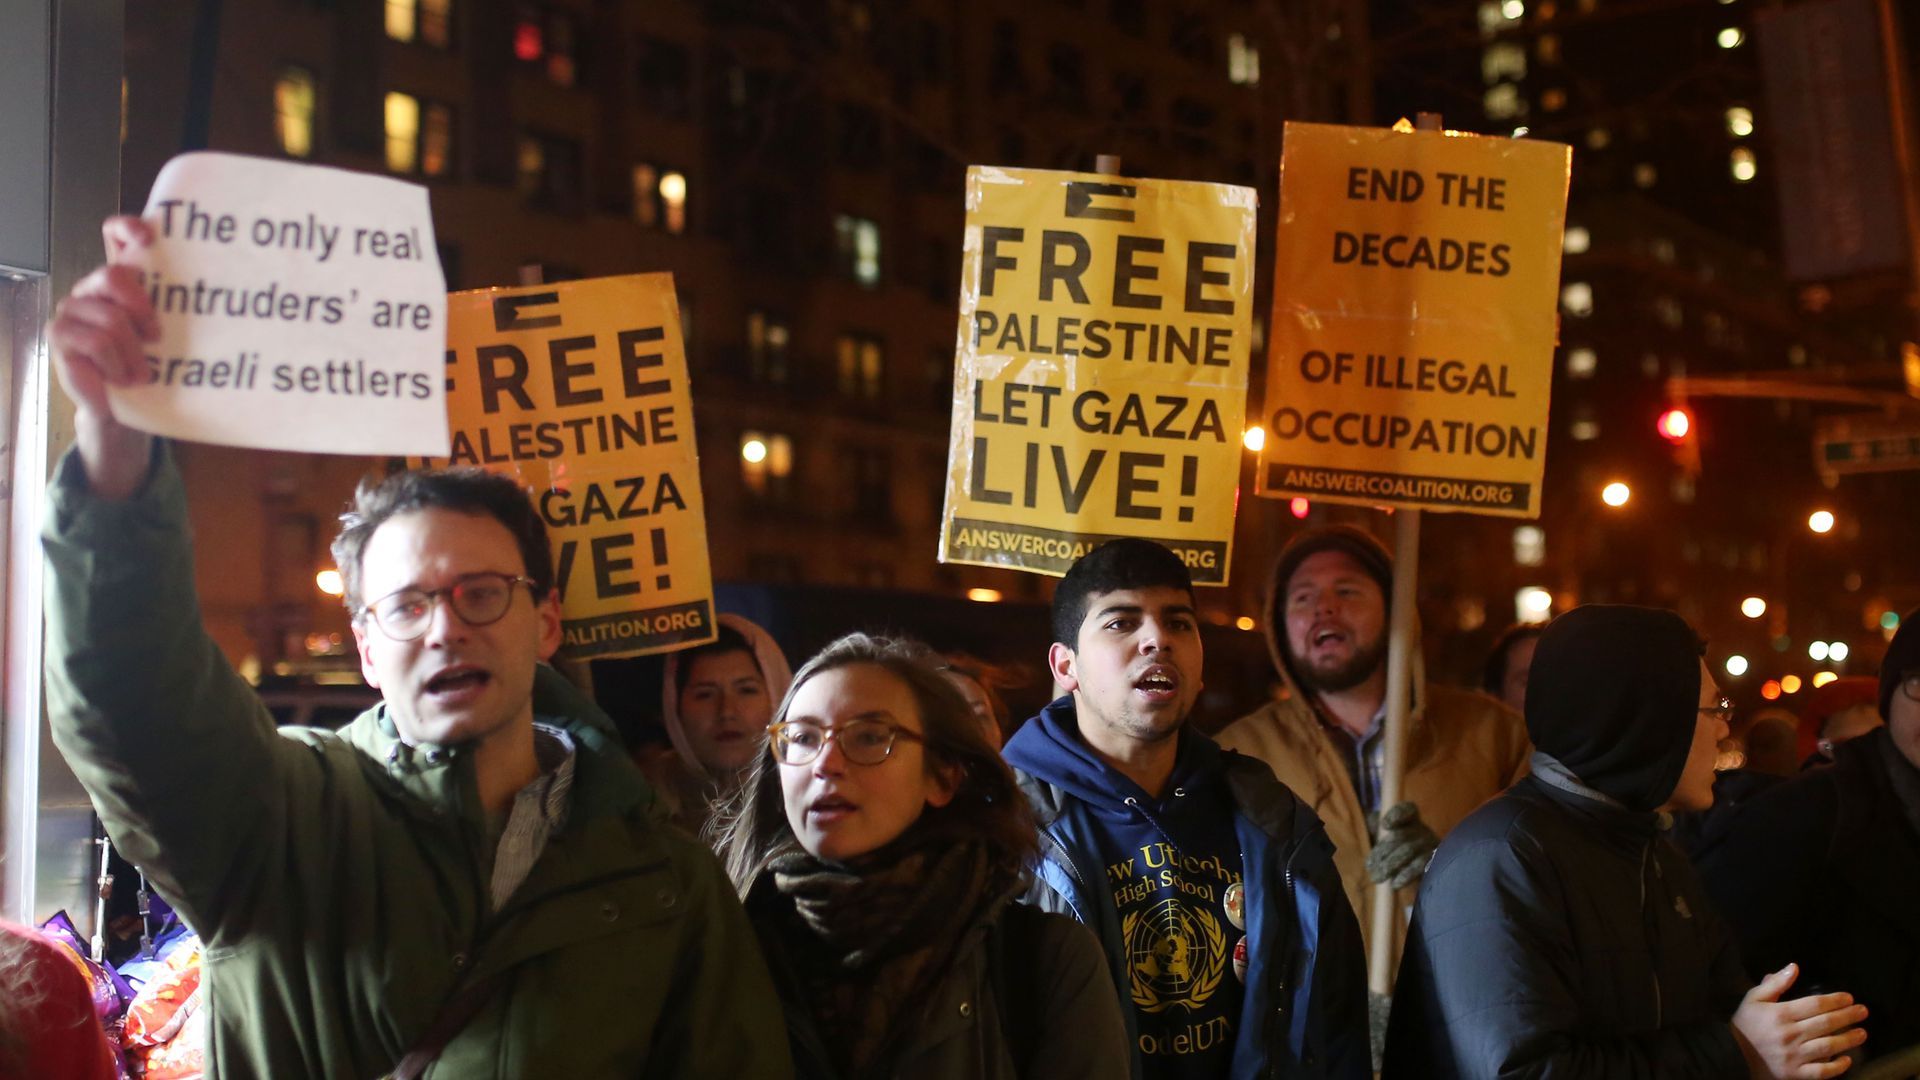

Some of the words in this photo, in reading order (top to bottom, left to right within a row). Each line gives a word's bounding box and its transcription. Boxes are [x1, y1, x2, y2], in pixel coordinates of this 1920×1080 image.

[1347, 167, 1424, 203] END
[1437, 172, 1506, 212] THE
[158, 200, 237, 244] The
[251, 213, 340, 264] only
[353, 226, 422, 262] real
[1333, 231, 1511, 277] DECADES
[979, 226, 1237, 315] FREE
[371, 299, 431, 330] are
[975, 311, 1232, 367] PALESTINE
[145, 351, 260, 390] sraeli
[271, 361, 431, 400] settlers
[1300, 350, 1354, 386] OF
[1364, 356, 1516, 399] ILLEGAL
[421, 406, 678, 468] ALESTINE
[974, 380, 1061, 428] LET
[1072, 391, 1226, 442] GAZA
[1271, 408, 1537, 460] OCCUPATION
[540, 472, 687, 528] GAZA
[970, 437, 1199, 522] LIVE!
[1284, 470, 1513, 504] ANSWERCOALITION.ORG
[1114, 875, 1157, 908] High
